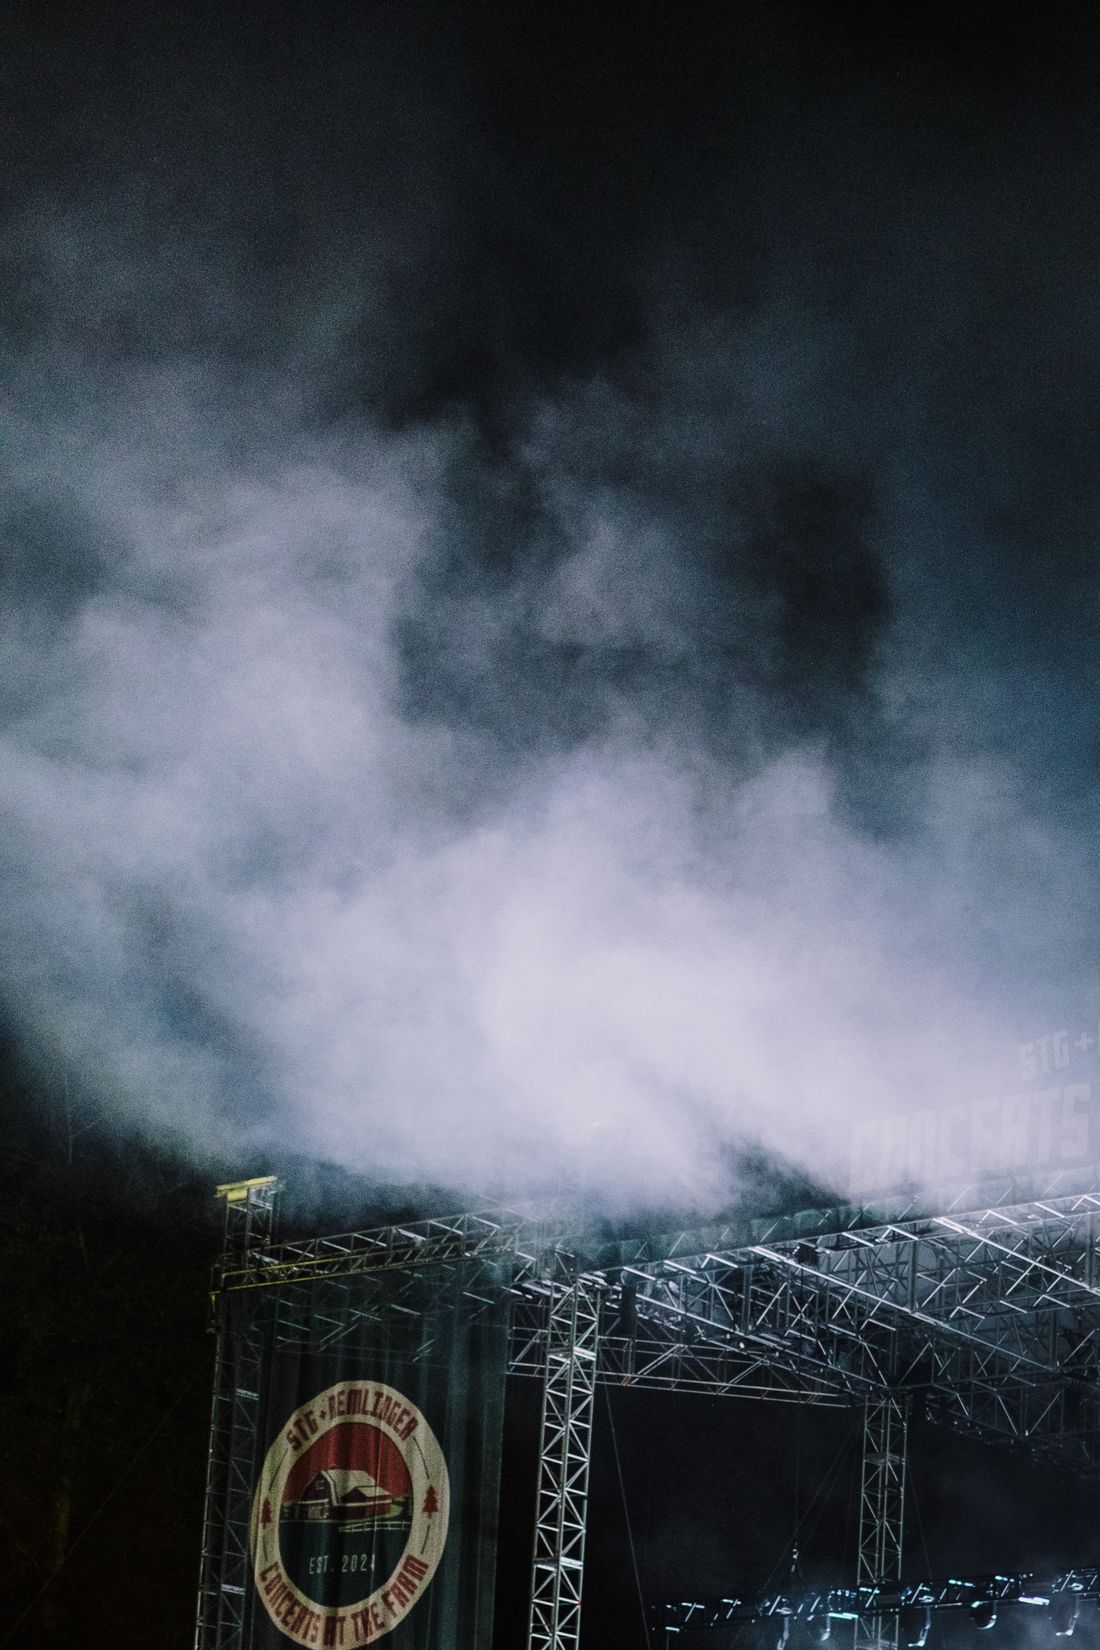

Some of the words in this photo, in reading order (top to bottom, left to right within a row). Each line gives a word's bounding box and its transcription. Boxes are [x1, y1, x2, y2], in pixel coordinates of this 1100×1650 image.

[1018, 1029, 1070, 1080] STG
[1075, 1032, 1093, 1052] +
[286, 1410, 320, 1451] STG
[327, 1389, 419, 1442] REMLINGER
[308, 1555, 335, 1575] EST.
[259, 1561, 321, 1644] CONCERTS
[322, 1615, 347, 1647] AT
[350, 1602, 385, 1642] THE
[381, 1554, 430, 1619] FARM
